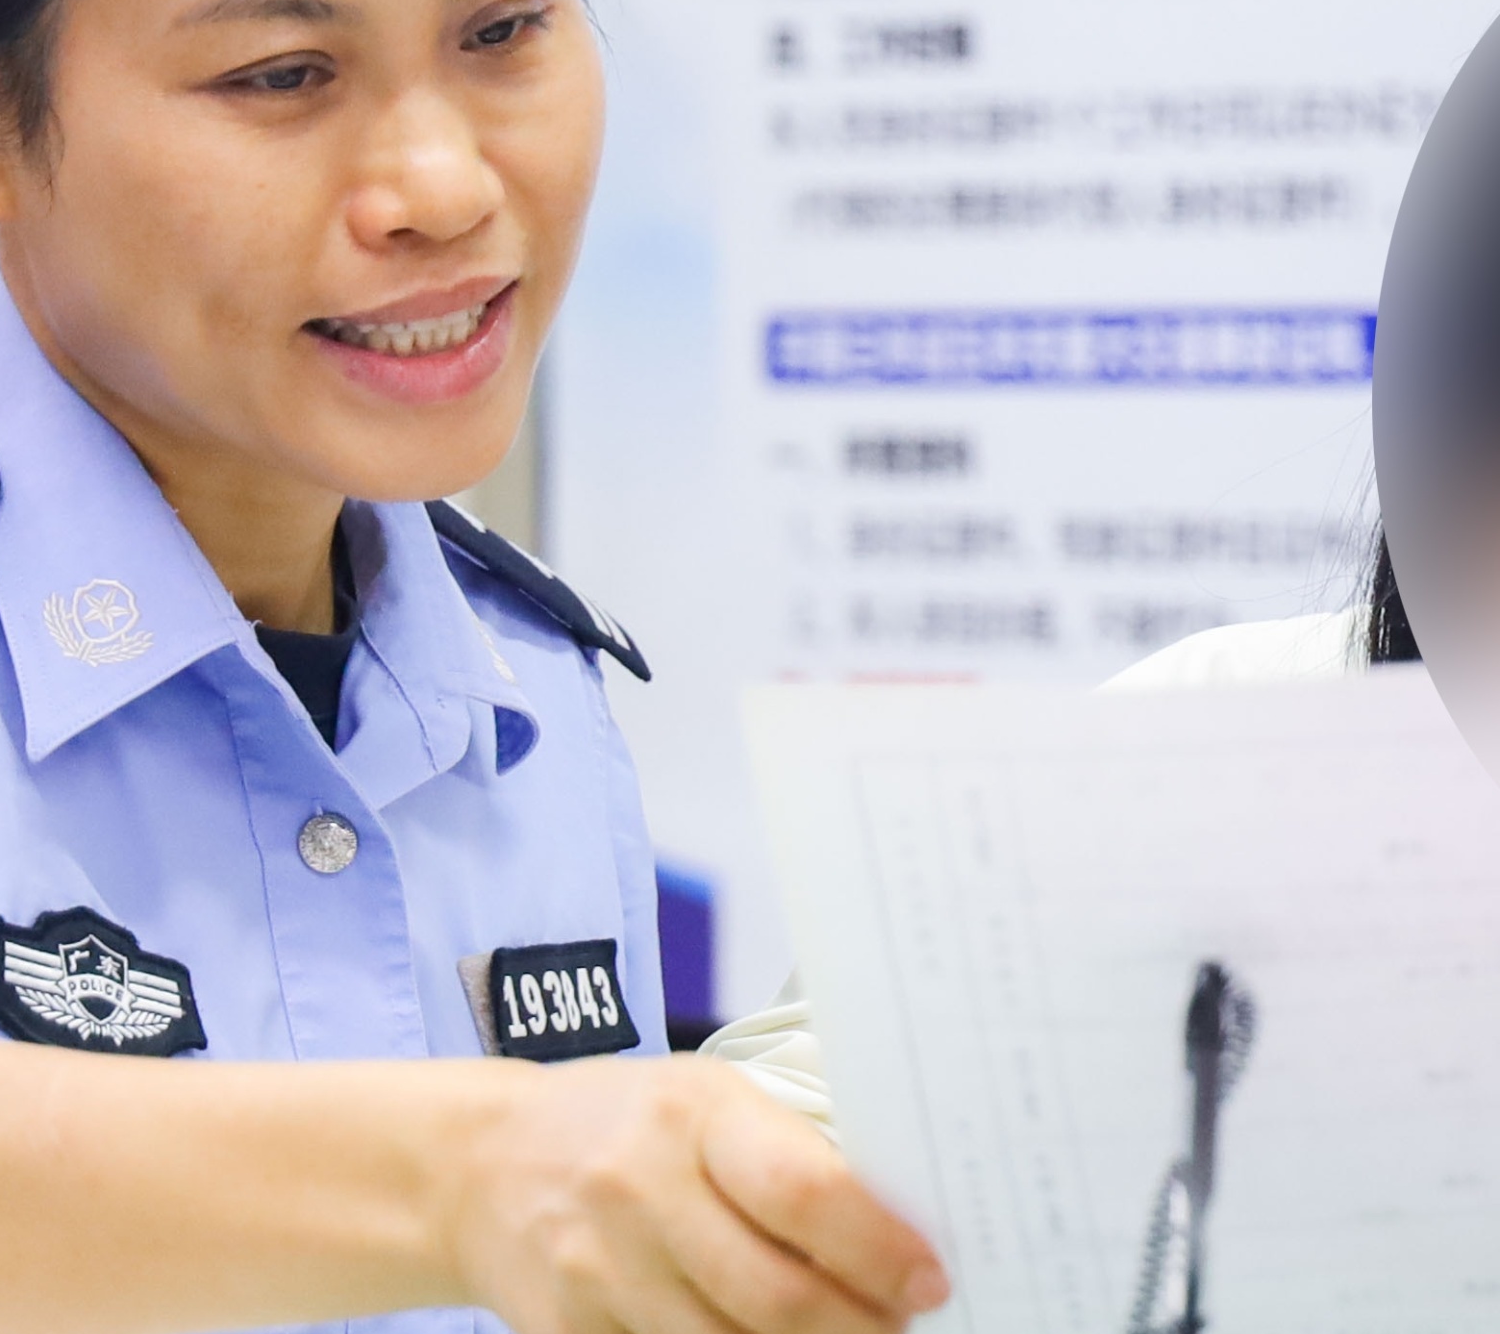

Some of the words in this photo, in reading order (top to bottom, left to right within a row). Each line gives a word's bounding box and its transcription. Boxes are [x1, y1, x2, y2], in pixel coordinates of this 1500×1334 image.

[67, 949, 122, 980] 广东
[67, 980, 125, 1002] POLICE
[503, 966, 619, 1038] 193843
